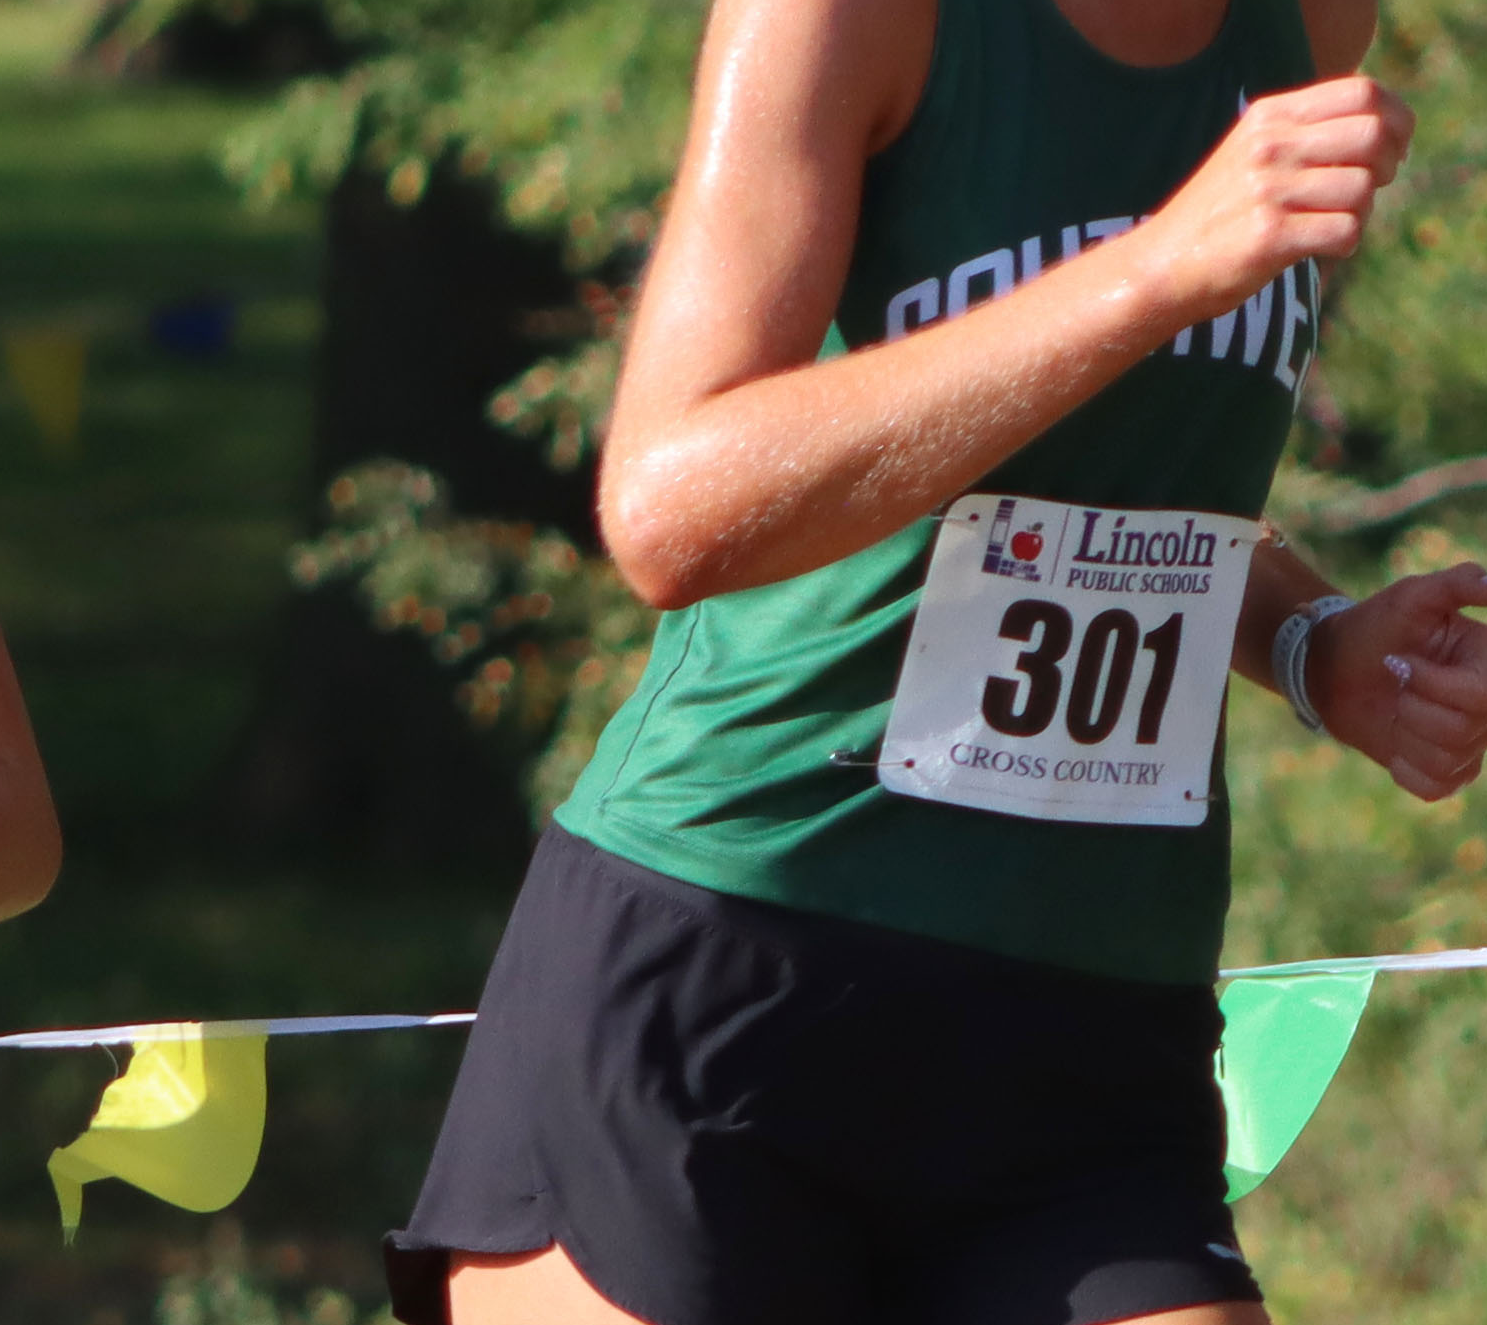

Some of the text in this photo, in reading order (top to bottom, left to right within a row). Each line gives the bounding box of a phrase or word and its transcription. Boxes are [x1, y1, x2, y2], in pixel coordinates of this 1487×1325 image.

[1072, 510, 1218, 567] Lincoln
[1066, 567, 1211, 595] PUBLIC SCHOOLS
[981, 598, 1184, 745] 301
[950, 742, 1165, 786] CROSS COUNTRY
